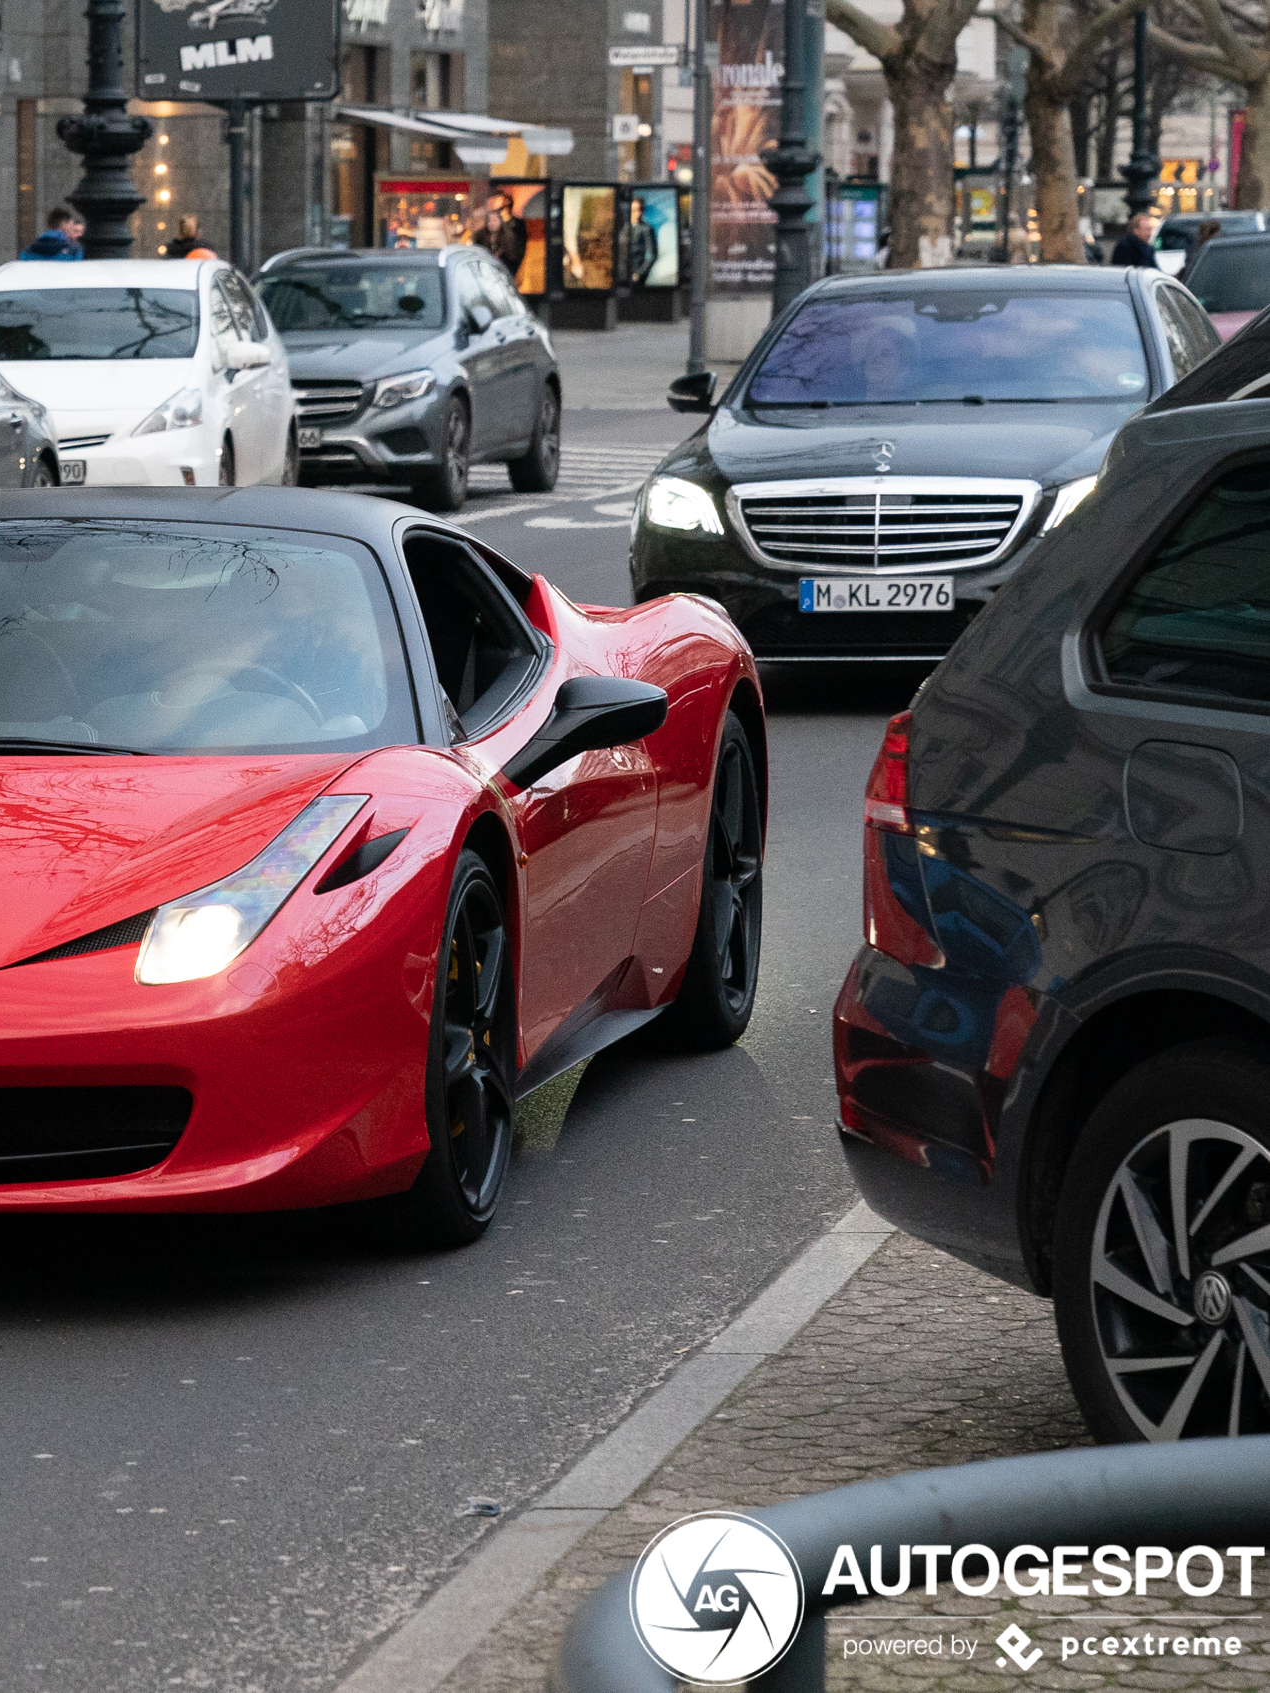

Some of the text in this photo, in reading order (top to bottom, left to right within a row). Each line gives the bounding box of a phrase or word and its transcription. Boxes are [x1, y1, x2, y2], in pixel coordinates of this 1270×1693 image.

[180, 35, 273, 71] MLM
[60, 463, 81, 480] 90
[816, 583, 950, 607] M KL 2976
